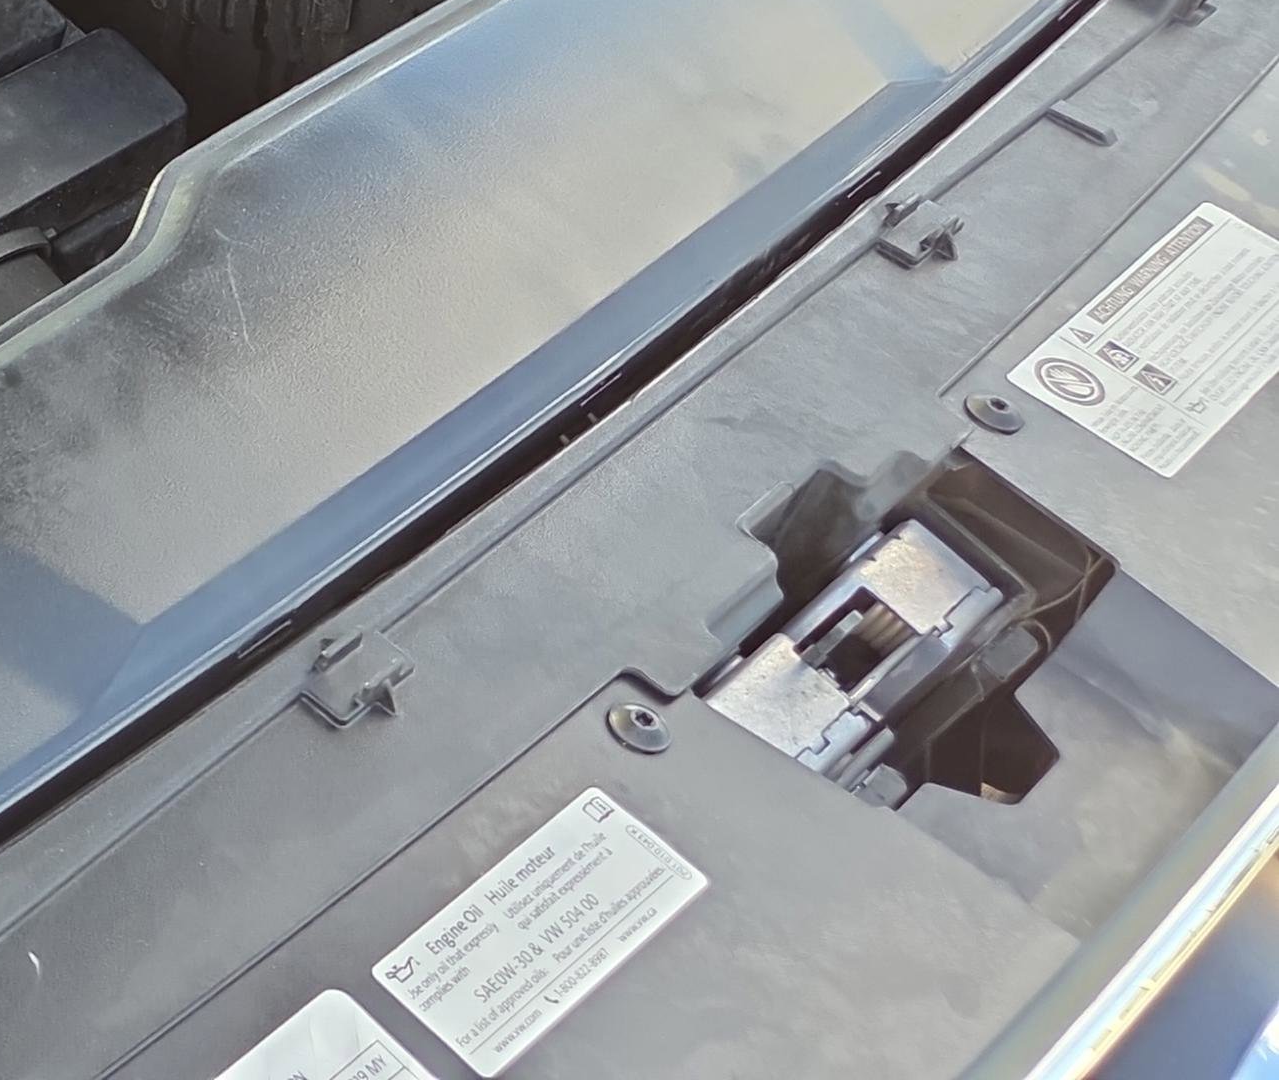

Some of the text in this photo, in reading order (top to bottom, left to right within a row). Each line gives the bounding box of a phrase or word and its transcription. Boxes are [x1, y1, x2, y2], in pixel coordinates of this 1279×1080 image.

[1090, 284, 1136, 321] ACHTUNG
[483, 843, 557, 906] Huile moteur
[527, 856, 579, 899] uniquement
[570, 847, 586, 861] de
[424, 903, 485, 958] Engine Oil
[515, 915, 535, 932] qui
[525, 940, 544, 957] &
[538, 921, 566, 945] VW
[558, 904, 586, 928] 504
[577, 891, 601, 912] 00
[550, 942, 574, 963] Pour
[569, 932, 588, 949] une
[418, 969, 443, 991] only
[434, 960, 451, 975] oil
[444, 947, 467, 966] that
[460, 920, 501, 955] expressly
[449, 964, 472, 984] with
[454, 1031, 473, 1048] For
[472, 1015, 491, 1032] list
[484, 1007, 500, 1021] of
[493, 977, 536, 1015] approved
[365, 1055, 387, 1075] MY
